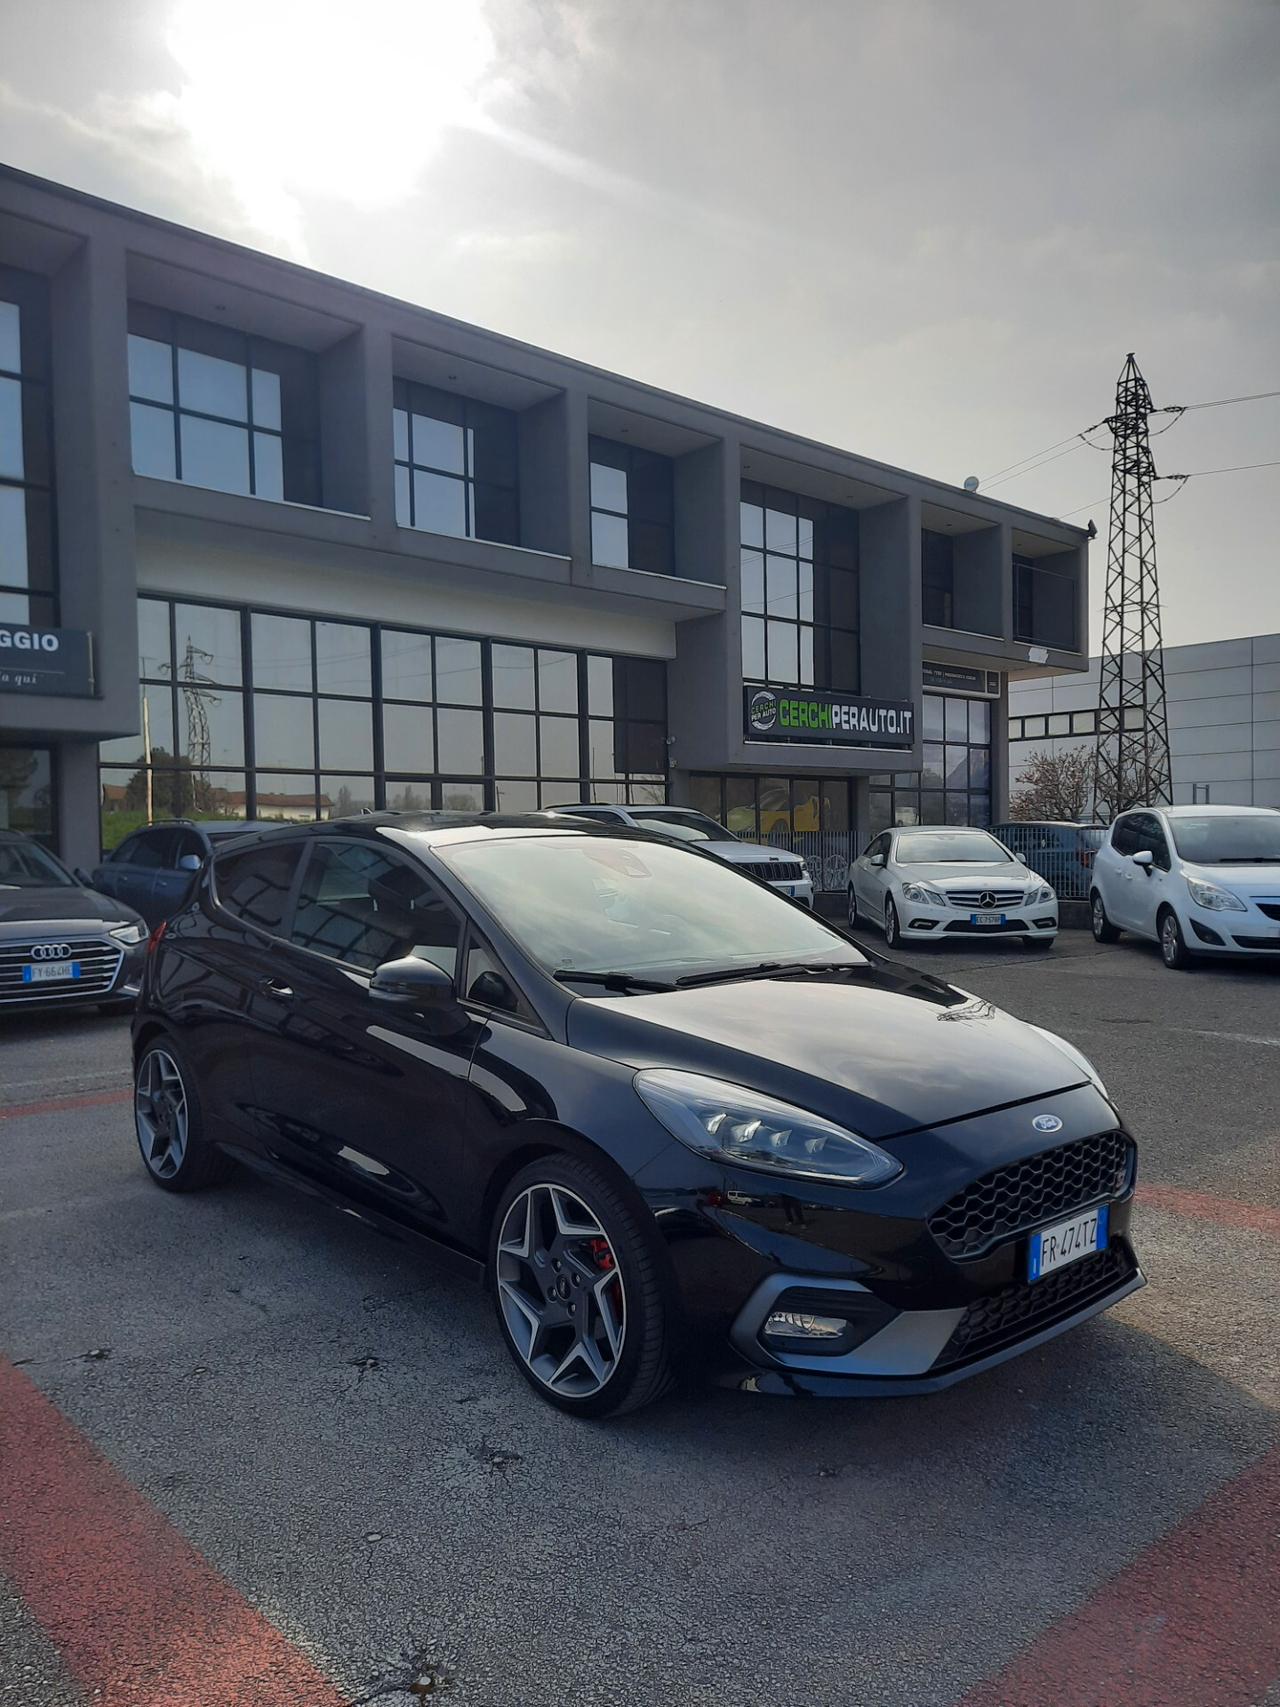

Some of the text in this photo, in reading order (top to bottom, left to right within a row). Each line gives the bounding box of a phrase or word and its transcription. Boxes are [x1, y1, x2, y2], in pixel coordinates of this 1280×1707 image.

[751, 700, 776, 714] CERCHI
[751, 708, 777, 721] PER AUTO
[779, 699, 912, 734] CERCHIPERAUTO.IT
